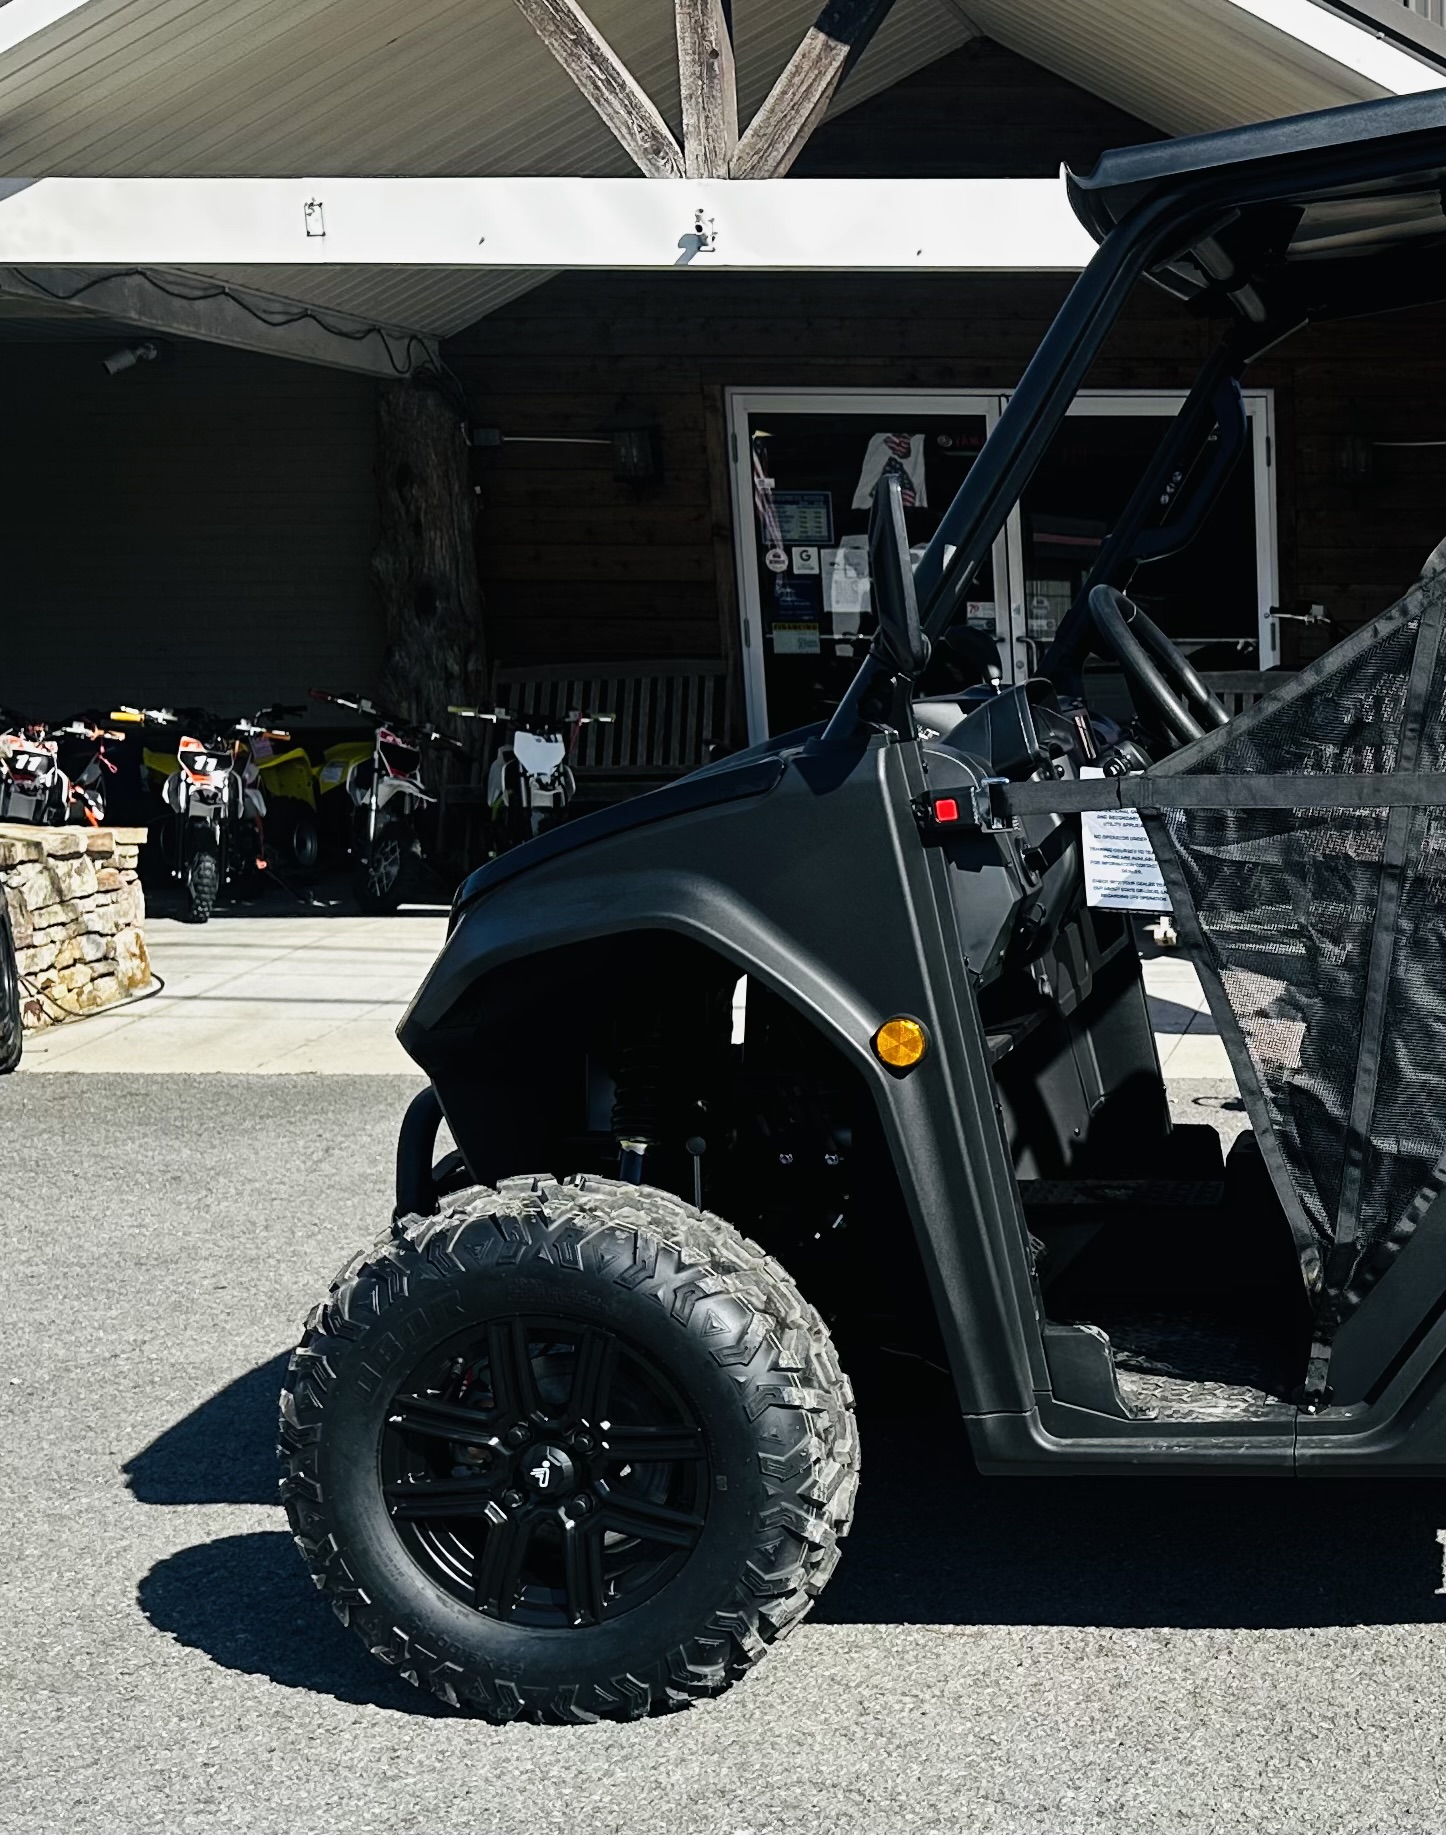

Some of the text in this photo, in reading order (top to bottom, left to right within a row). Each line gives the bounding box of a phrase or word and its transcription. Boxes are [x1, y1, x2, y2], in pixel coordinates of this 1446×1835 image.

[800, 550, 811, 561] G
[15, 754, 41, 771] 11
[192, 755, 217, 772] 11
